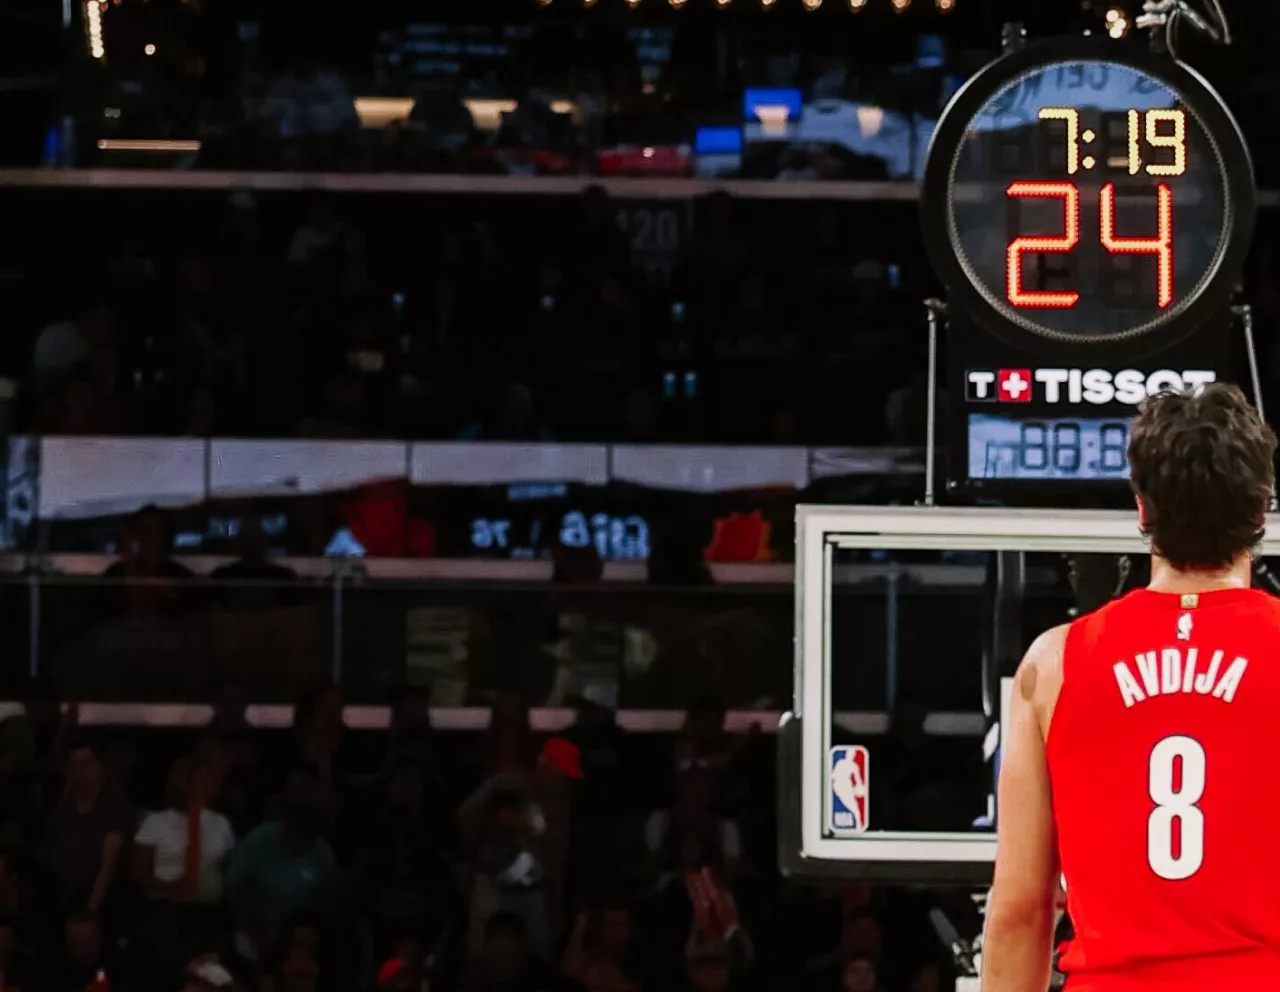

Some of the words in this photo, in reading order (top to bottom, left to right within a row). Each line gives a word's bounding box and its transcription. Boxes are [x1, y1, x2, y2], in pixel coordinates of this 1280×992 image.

[1038, 107, 1186, 176] 7:19
[1006, 180, 1173, 308] 24
[1035, 368, 1216, 404] TISSOT
[1112, 647, 1249, 708] AVDIJA
[1147, 733, 1206, 881] 8
